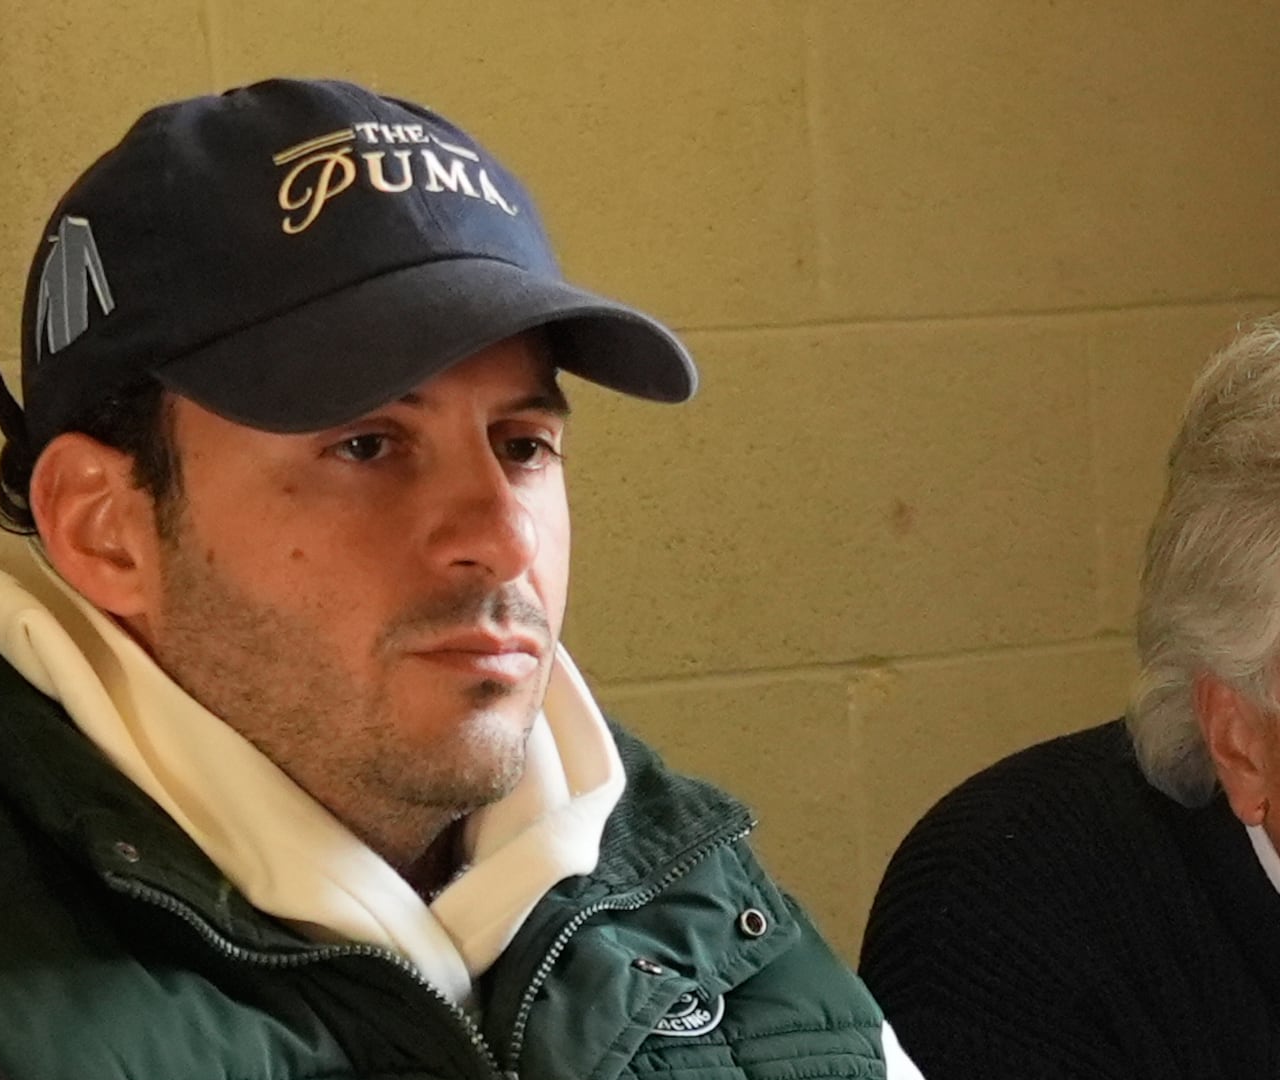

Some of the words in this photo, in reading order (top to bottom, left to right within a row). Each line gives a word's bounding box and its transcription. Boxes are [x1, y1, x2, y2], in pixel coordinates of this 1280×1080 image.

[355, 122, 430, 144] THE
[278, 145, 518, 234] PUMA
[657, 1009, 712, 1031] ACING
